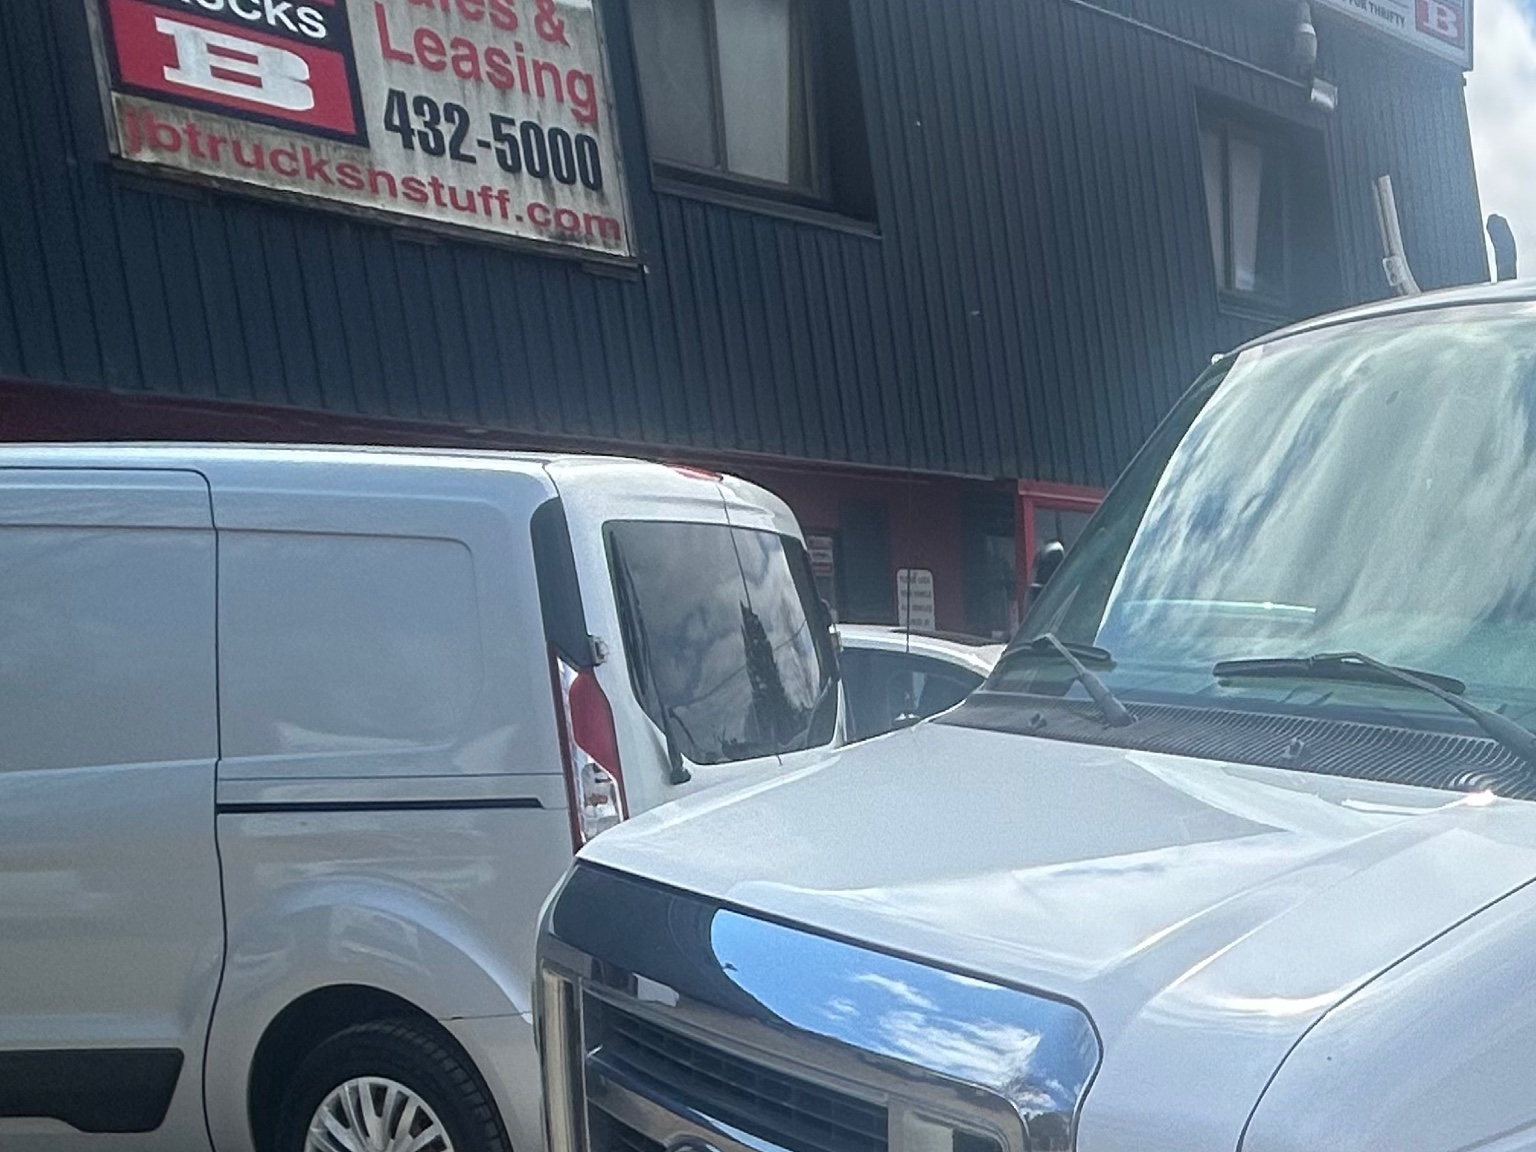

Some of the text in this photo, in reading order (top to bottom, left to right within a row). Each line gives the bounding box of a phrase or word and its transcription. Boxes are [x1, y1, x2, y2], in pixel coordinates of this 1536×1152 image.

[374, 1, 599, 124] Leasing
[533, 0, 571, 49] &
[1368, 1, 1405, 28] THRIFTY
[123, 105, 622, 241] jbtrucksnstuff.com
[383, 87, 603, 192] 432-5000
